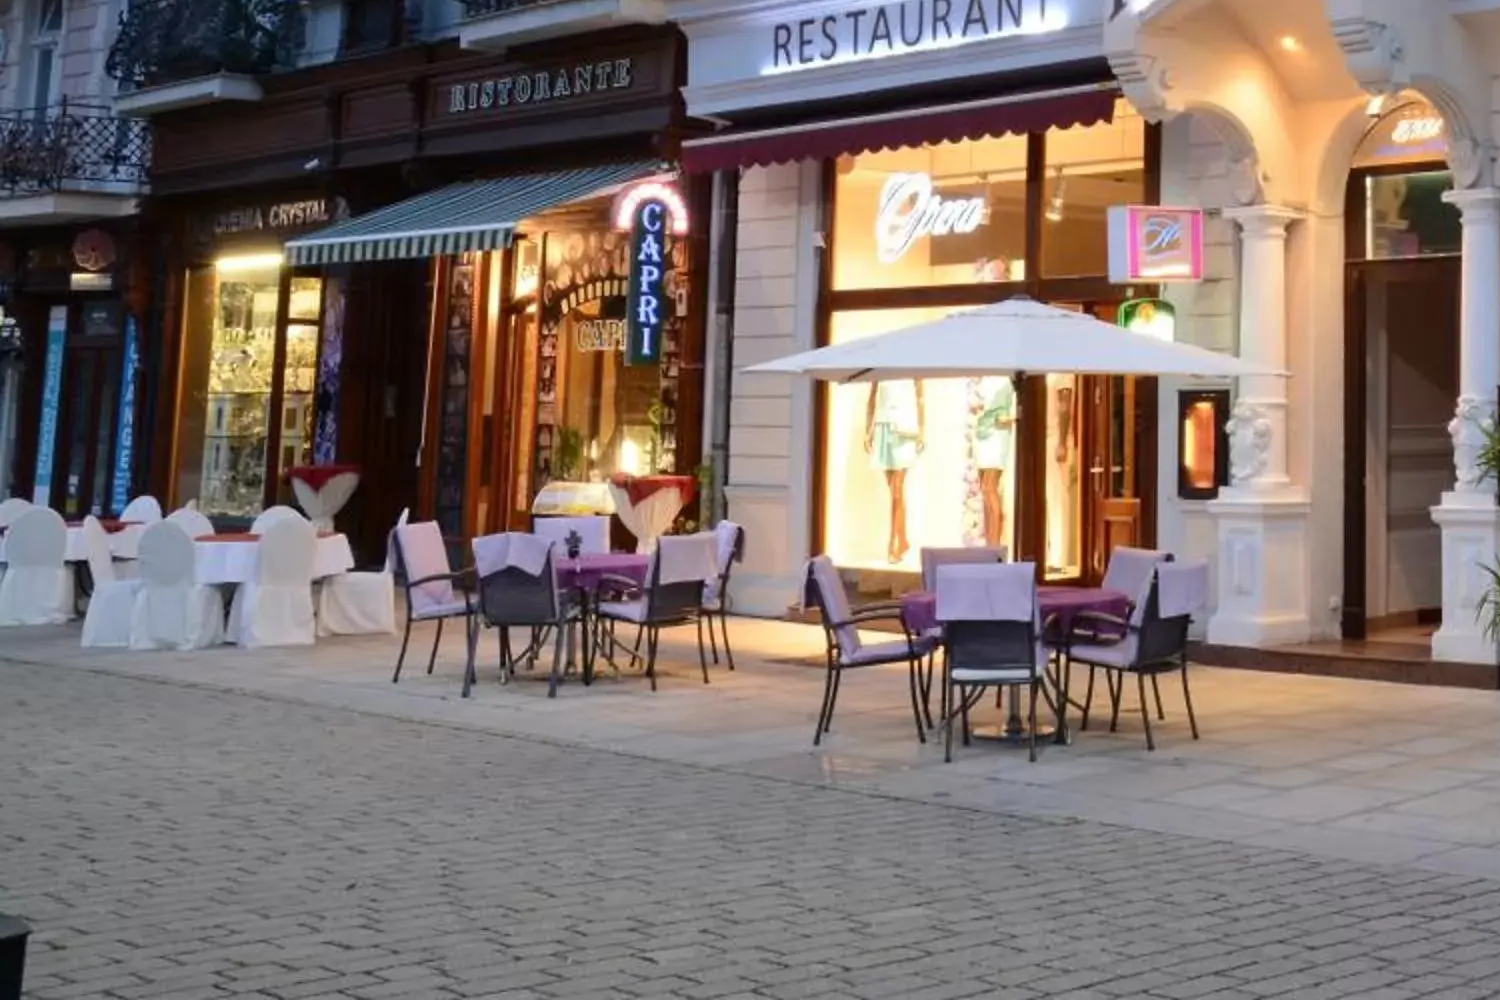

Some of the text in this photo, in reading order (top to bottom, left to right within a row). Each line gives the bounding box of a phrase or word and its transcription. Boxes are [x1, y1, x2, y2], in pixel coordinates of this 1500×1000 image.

[449, 58, 632, 113] RISTORANTE
[269, 199, 328, 227] CRYSTAL
[637, 203, 663, 356] CAPRI
